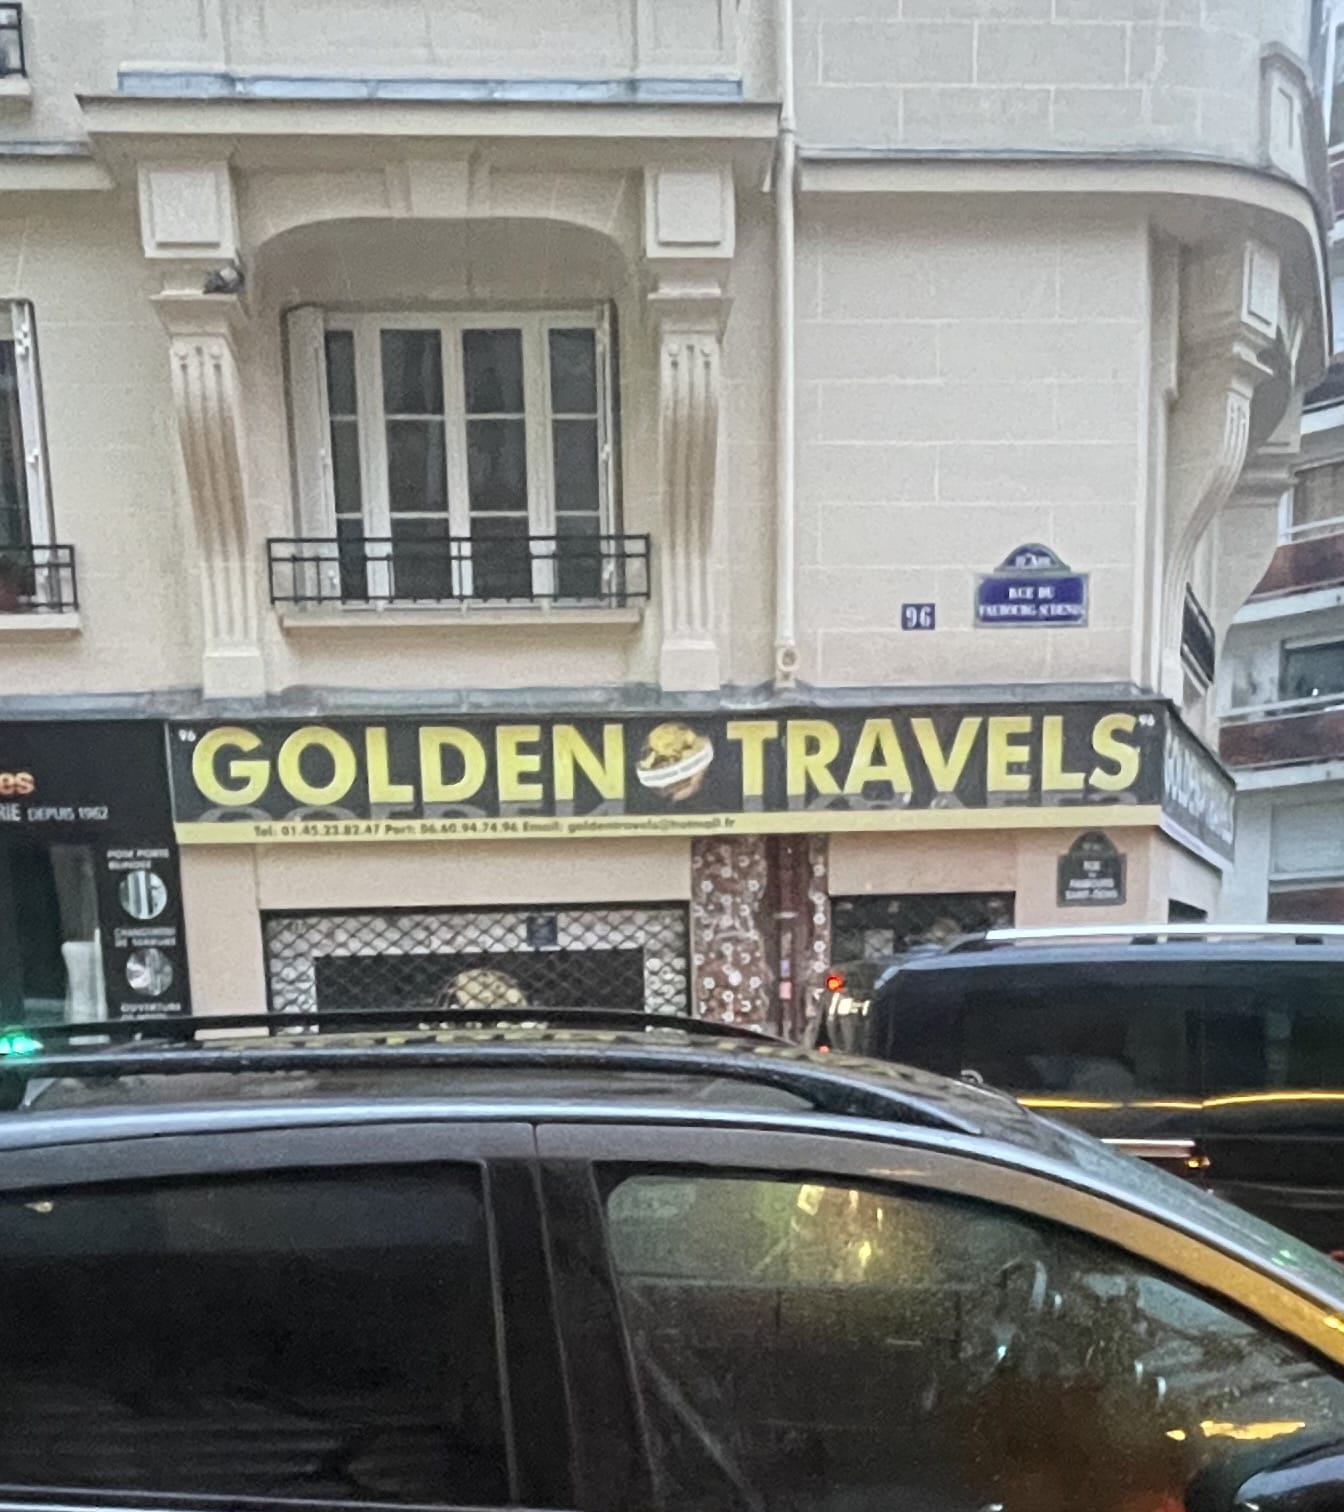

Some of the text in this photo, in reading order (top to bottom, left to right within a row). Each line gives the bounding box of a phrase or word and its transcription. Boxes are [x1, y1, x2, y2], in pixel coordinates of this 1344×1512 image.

[905, 605, 933, 628] 96
[191, 725, 625, 807] GOLDEN
[726, 712, 1141, 793] TRAVELS
